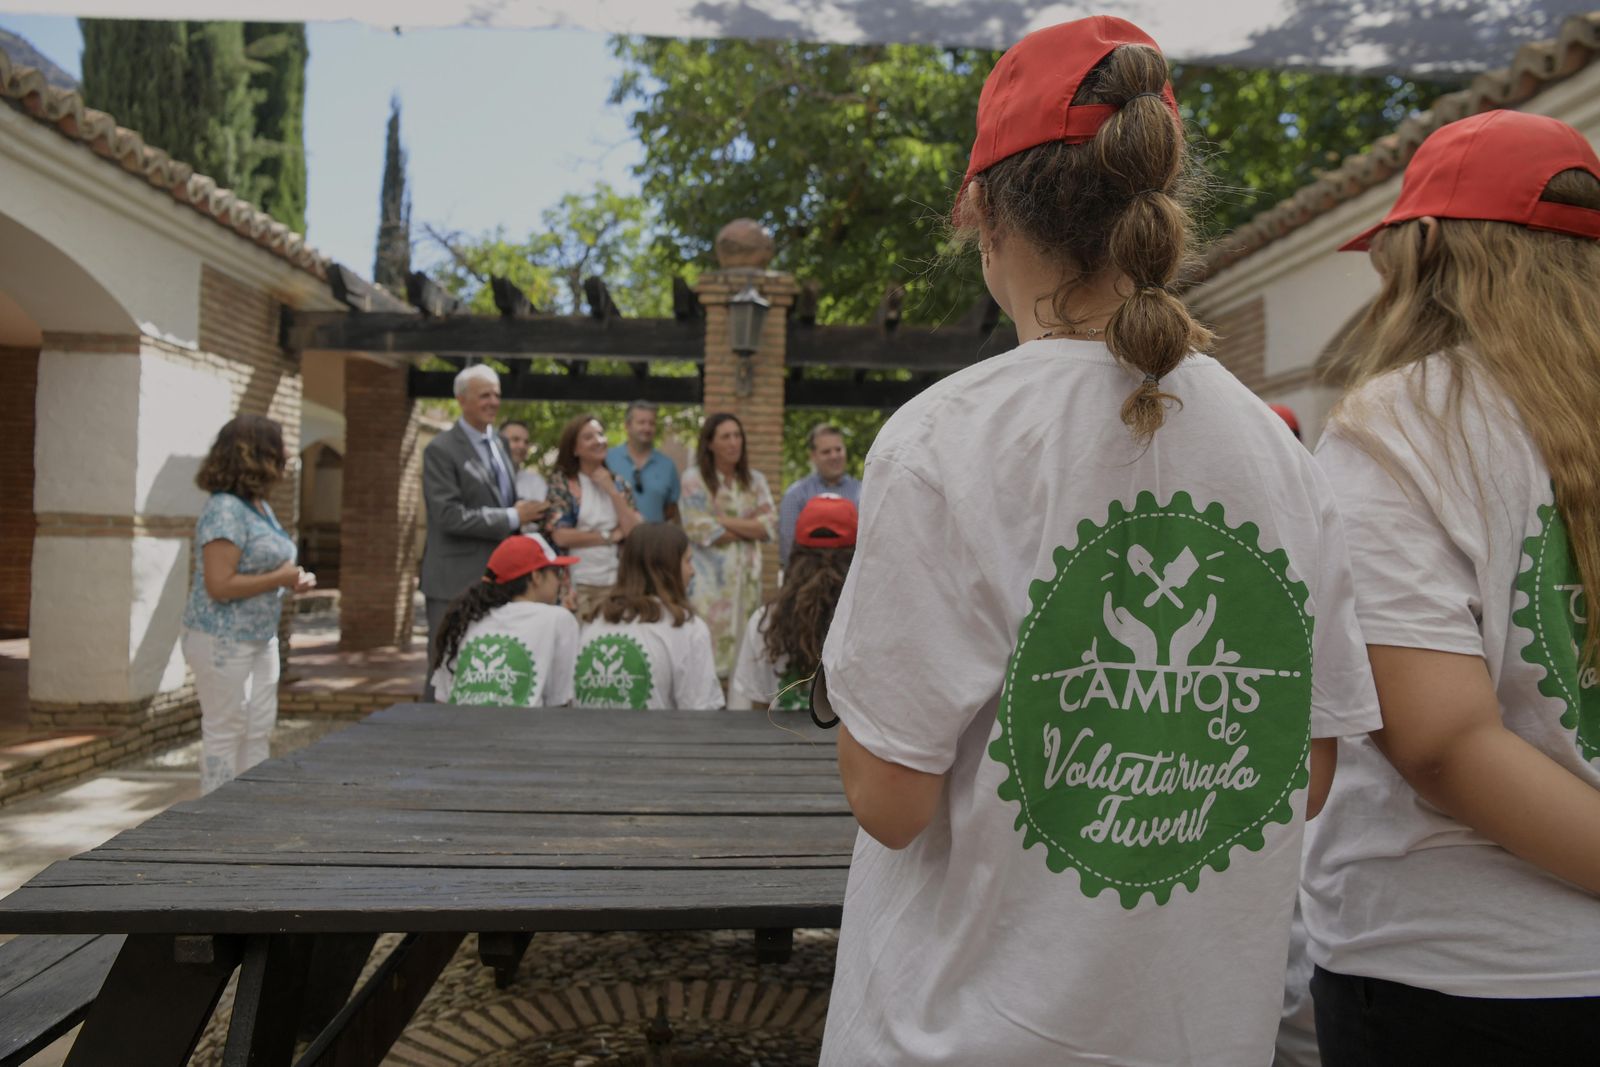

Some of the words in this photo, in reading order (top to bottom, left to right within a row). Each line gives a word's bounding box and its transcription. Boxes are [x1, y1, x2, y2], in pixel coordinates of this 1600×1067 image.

[1058, 668, 1261, 713] CAMPOS
[1208, 708, 1247, 745] de
[1043, 722, 1260, 796] Voluntariado
[1080, 791, 1217, 848] Juvenil
